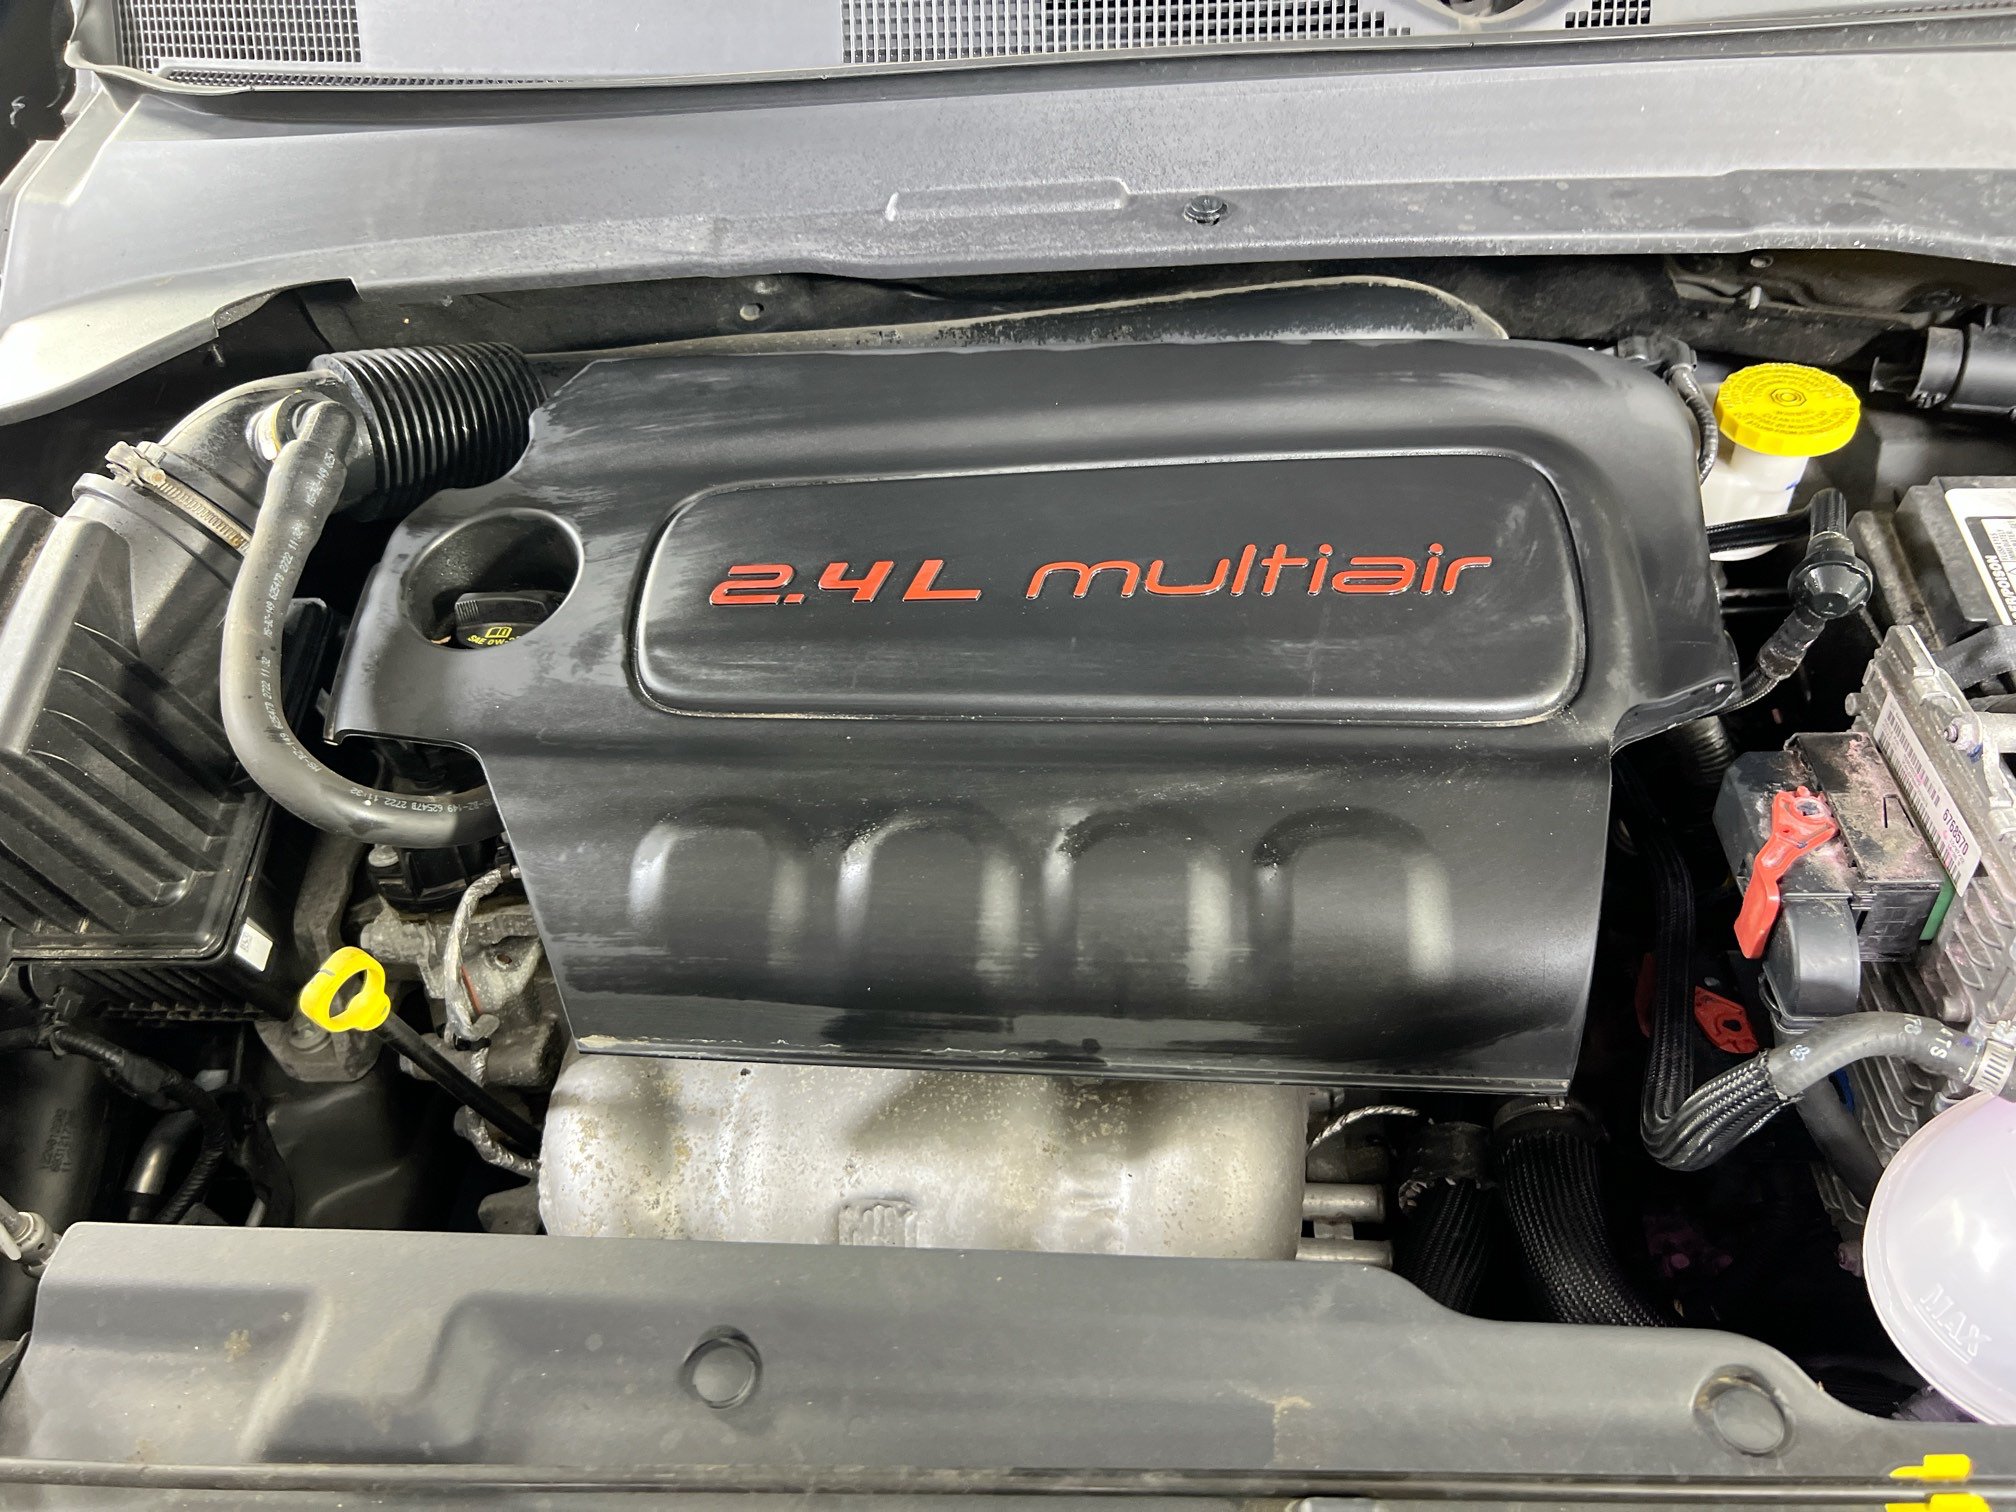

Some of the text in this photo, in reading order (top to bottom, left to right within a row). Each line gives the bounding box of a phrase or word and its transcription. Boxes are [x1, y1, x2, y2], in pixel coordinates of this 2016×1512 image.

[1026, 542, 1493, 600] multiair
[467, 634, 487, 645] SAE
[384, 797, 407, 809] 2722
[1942, 808, 1969, 856] 6768570
[1919, 1282, 1992, 1357] MAX
